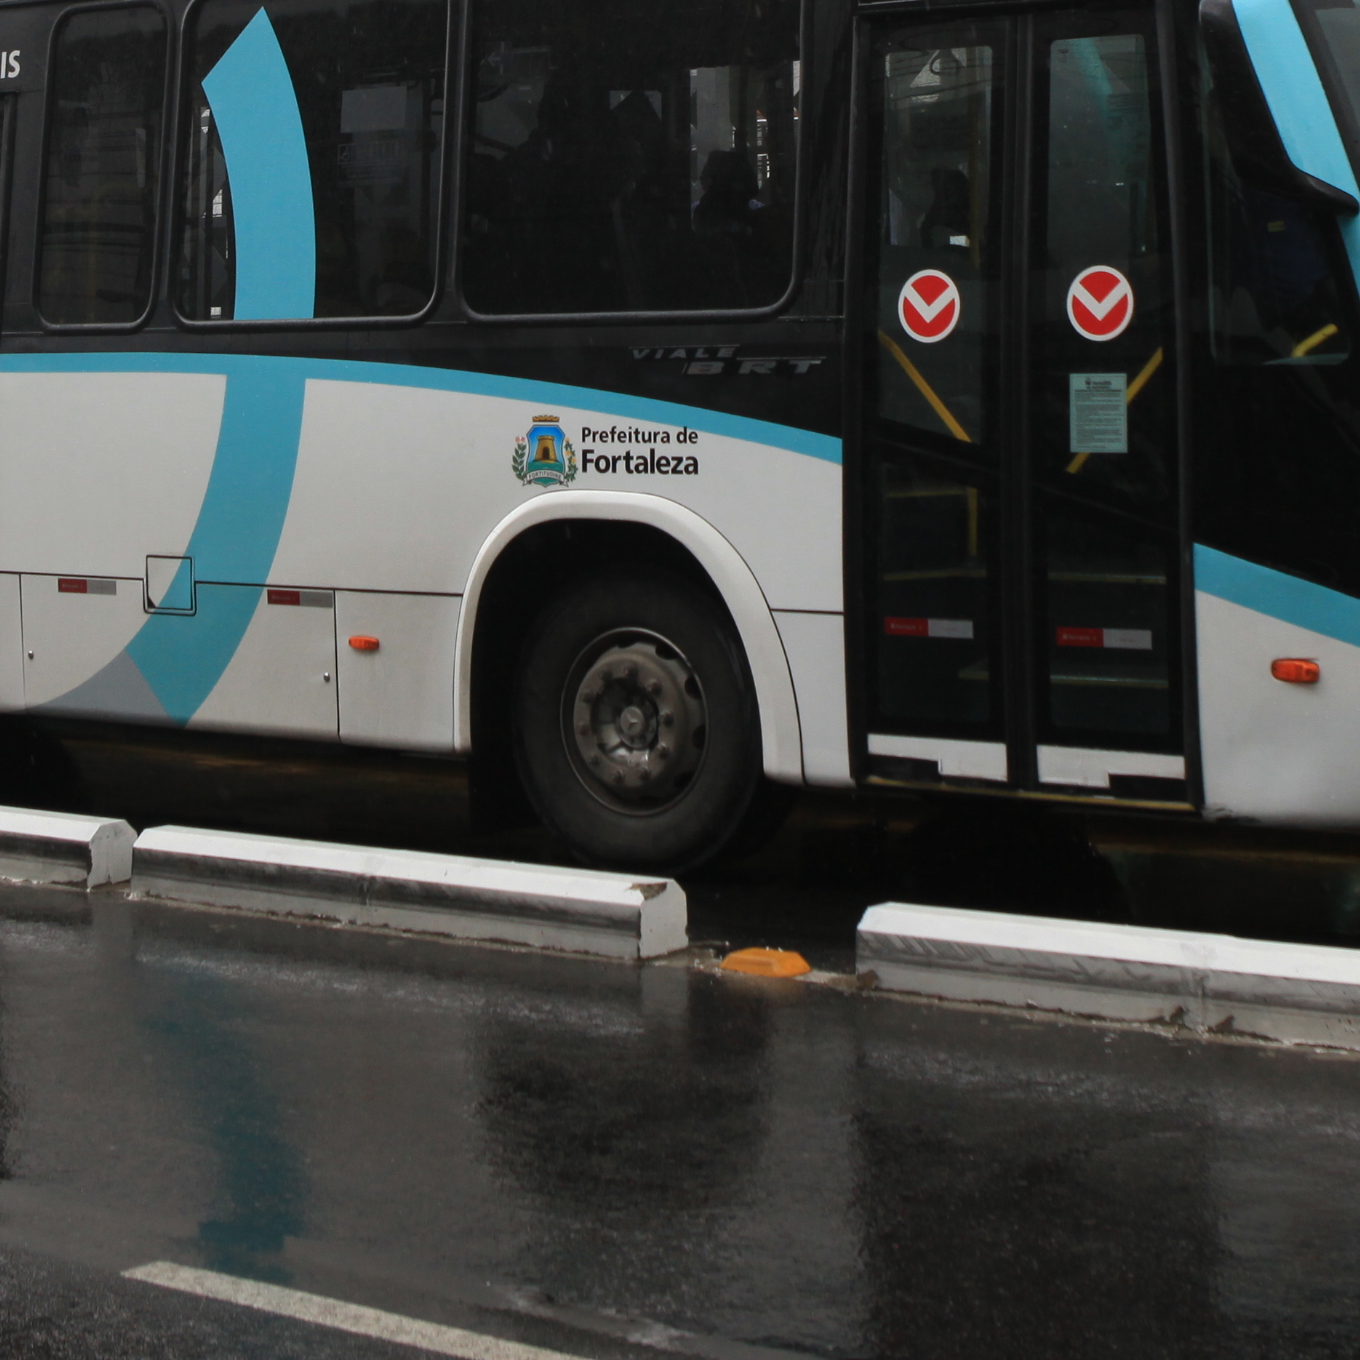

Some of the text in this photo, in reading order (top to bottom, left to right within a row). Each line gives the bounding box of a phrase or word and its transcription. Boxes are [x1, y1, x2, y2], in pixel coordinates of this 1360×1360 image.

[632, 347, 737, 360] VIALE
[686, 359, 823, 376] BRT
[581, 426, 699, 444] Prefeitura de
[581, 448, 699, 475] Fortaleza
